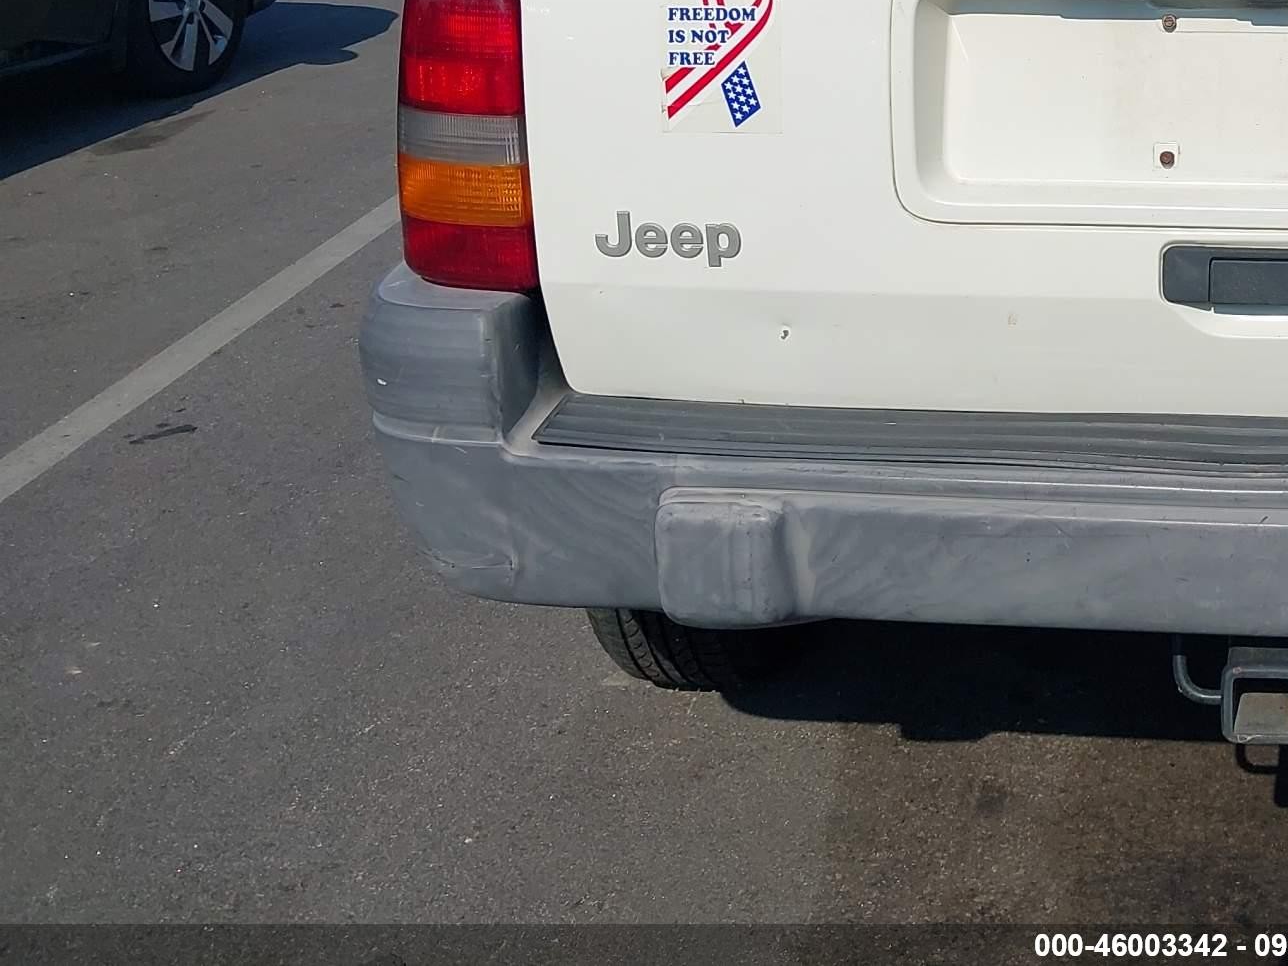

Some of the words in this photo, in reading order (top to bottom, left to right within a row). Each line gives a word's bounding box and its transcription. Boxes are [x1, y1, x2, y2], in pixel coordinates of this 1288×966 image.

[668, 7, 756, 21] FREEDOM
[668, 30, 686, 43] IS
[691, 30, 729, 43] NOT
[668, 52, 716, 65] FREE
[595, 210, 742, 268] Jeep
